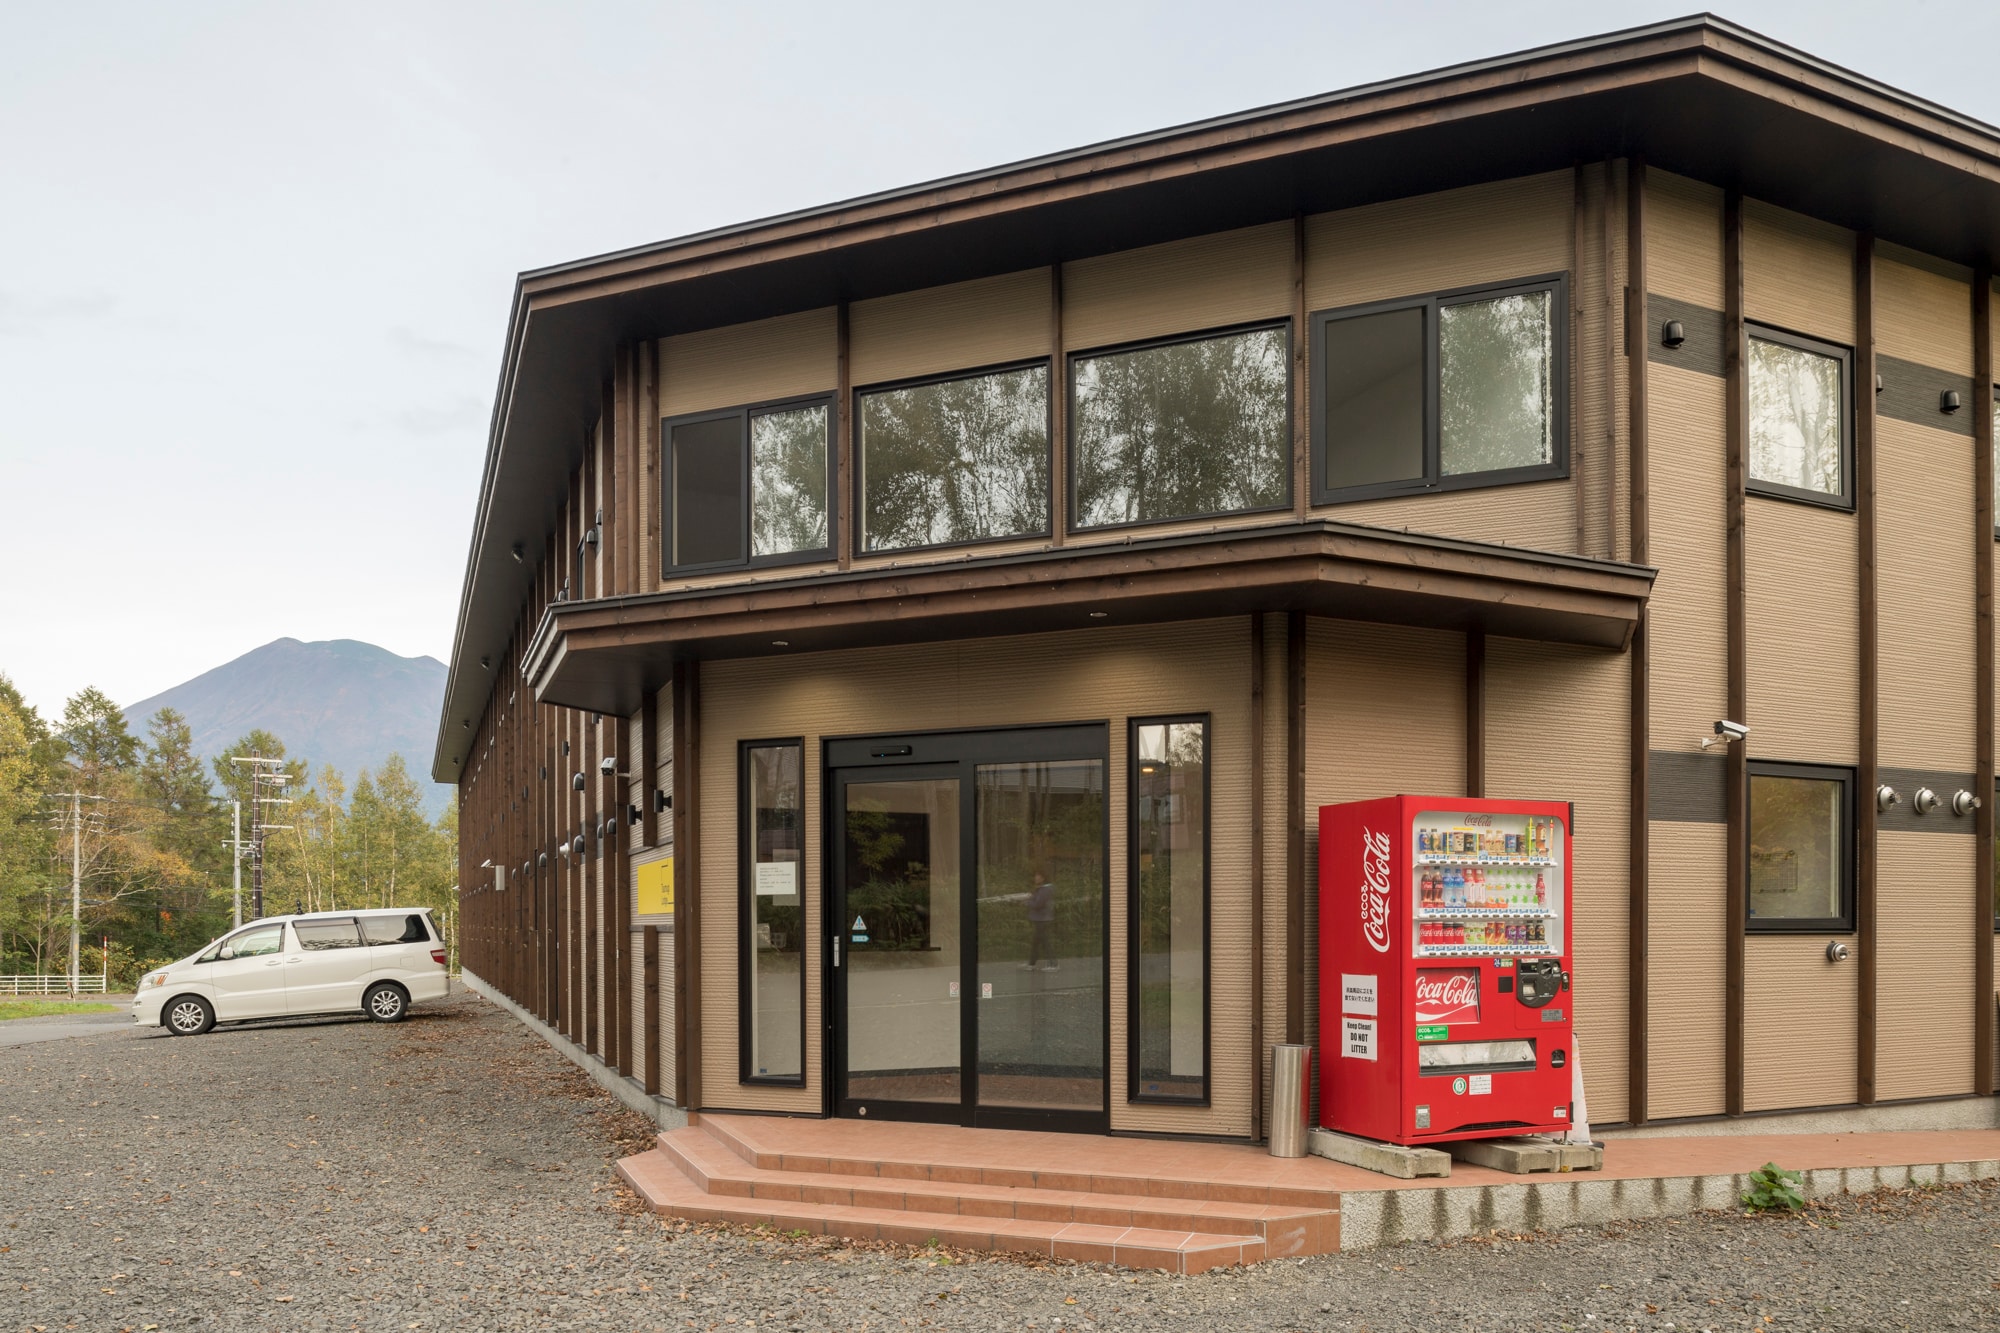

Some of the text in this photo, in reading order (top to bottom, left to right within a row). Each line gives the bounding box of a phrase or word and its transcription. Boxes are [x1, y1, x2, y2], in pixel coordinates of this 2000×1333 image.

[1464, 814, 1493, 826] Coca-Cola
[1363, 825, 1390, 953] Coca-Cola
[1347, 1022, 1357, 1030] Keep
[1350, 1032, 1368, 1042] DO NOT
[1351, 1044, 1367, 1054] LITTER
